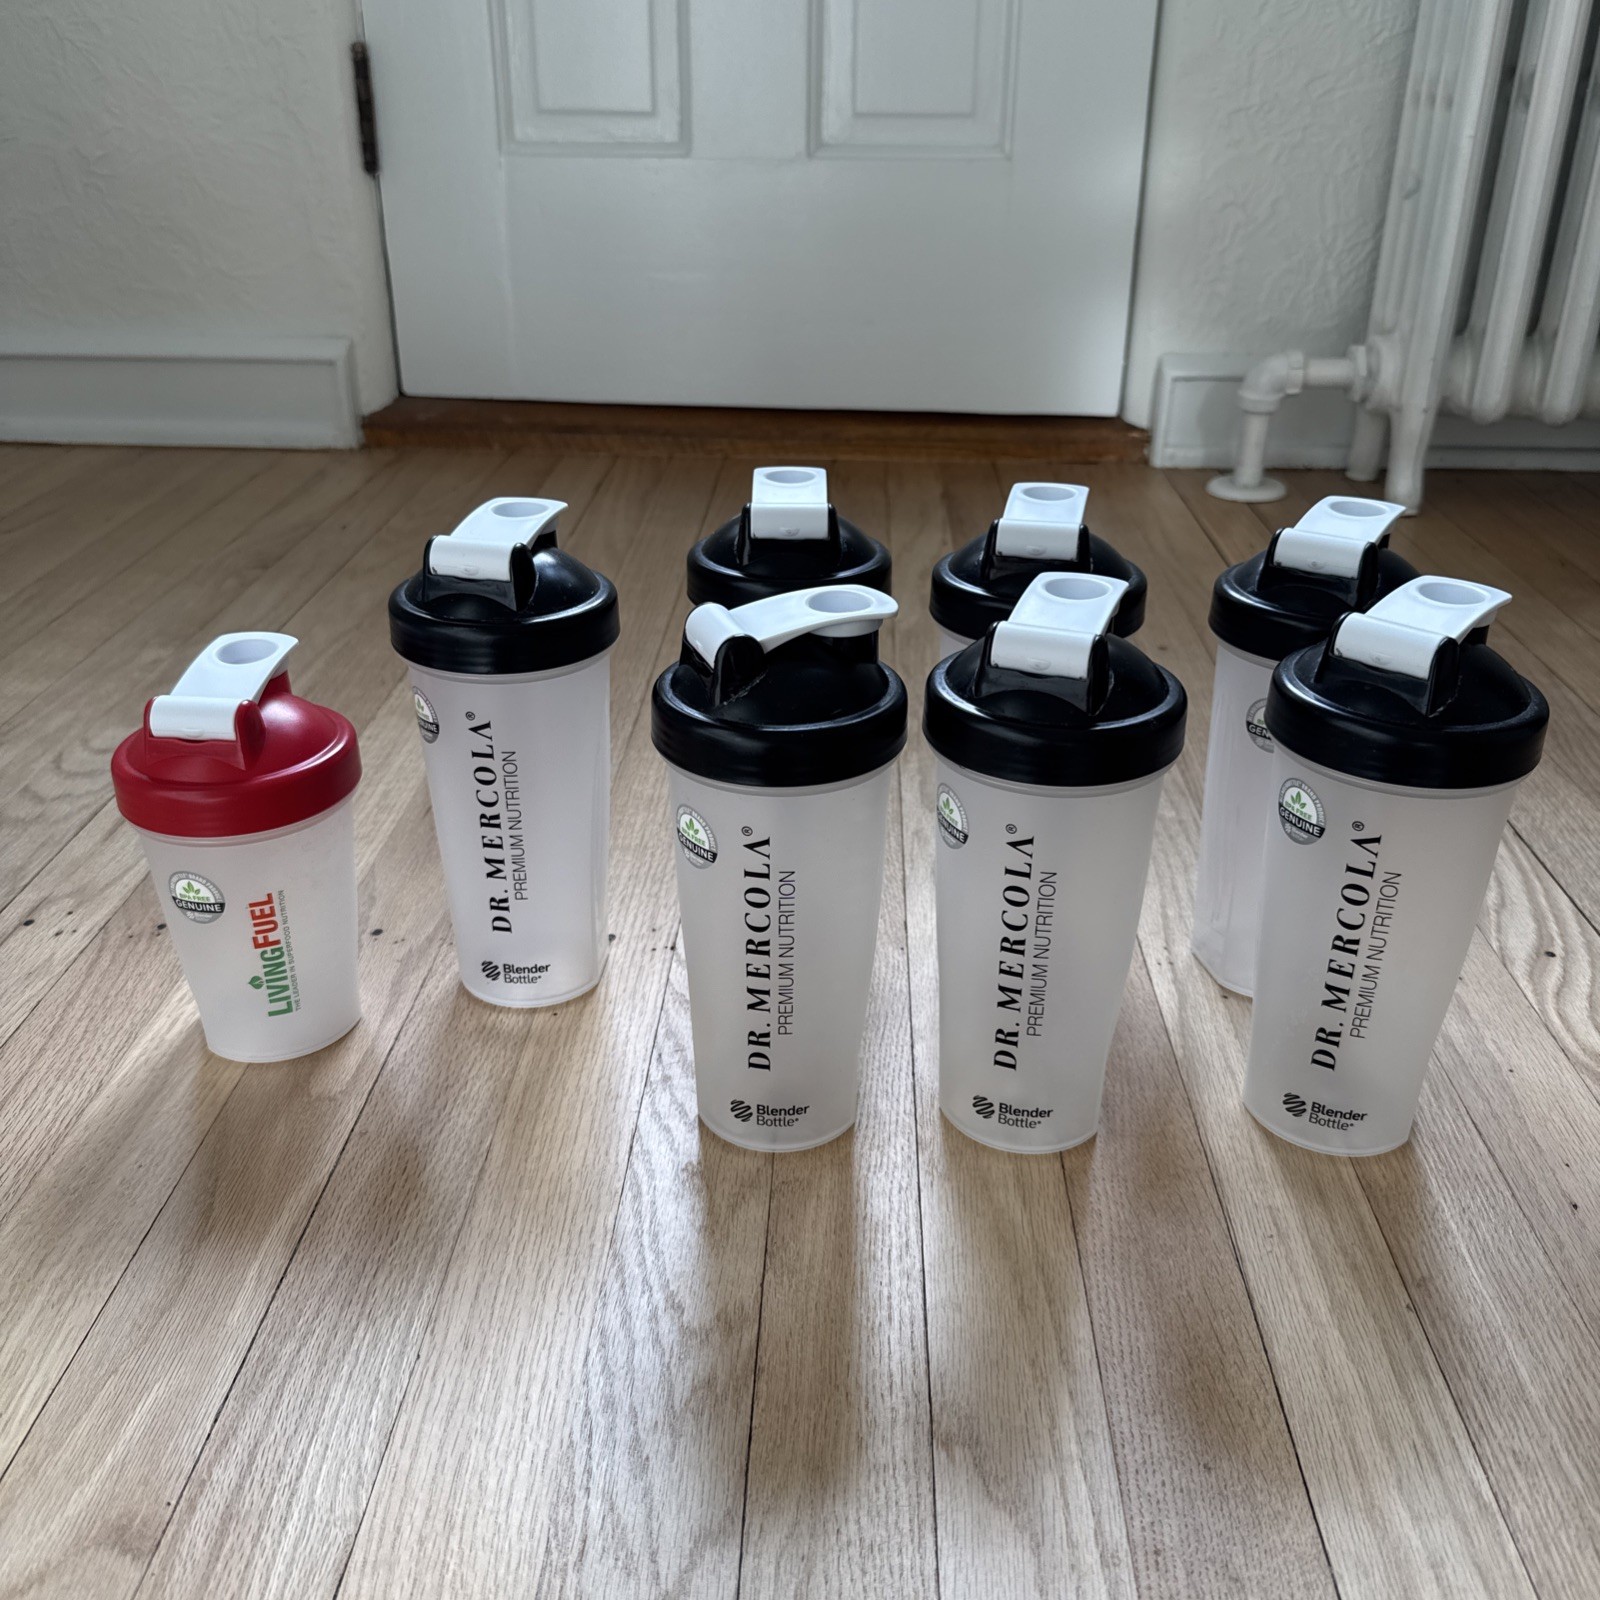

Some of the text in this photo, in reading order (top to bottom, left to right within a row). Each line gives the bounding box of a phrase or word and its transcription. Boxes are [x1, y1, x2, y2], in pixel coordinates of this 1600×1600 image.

[501, 752, 528, 900] PREMIUM NUTRITION
[1280, 806, 1321, 837] GENUINE
[175, 898, 222, 912] GENUINE
[489, 890, 512, 933] DR.
[503, 964, 550, 974] Blender
[778, 871, 795, 1035] PREMIUM NUTRITION
[1027, 872, 1057, 1036] PREMIUM NUTRITION
[1350, 872, 1402, 1038] PREMIUM NUTRITION
[748, 1023, 770, 1071] DR.
[994, 1023, 1020, 1071] DR.
[1311, 1023, 1343, 1071] DR.
[757, 1104, 809, 1116] Blender
[999, 1103, 1053, 1118] Blender
[1310, 1102, 1367, 1121] Blender
